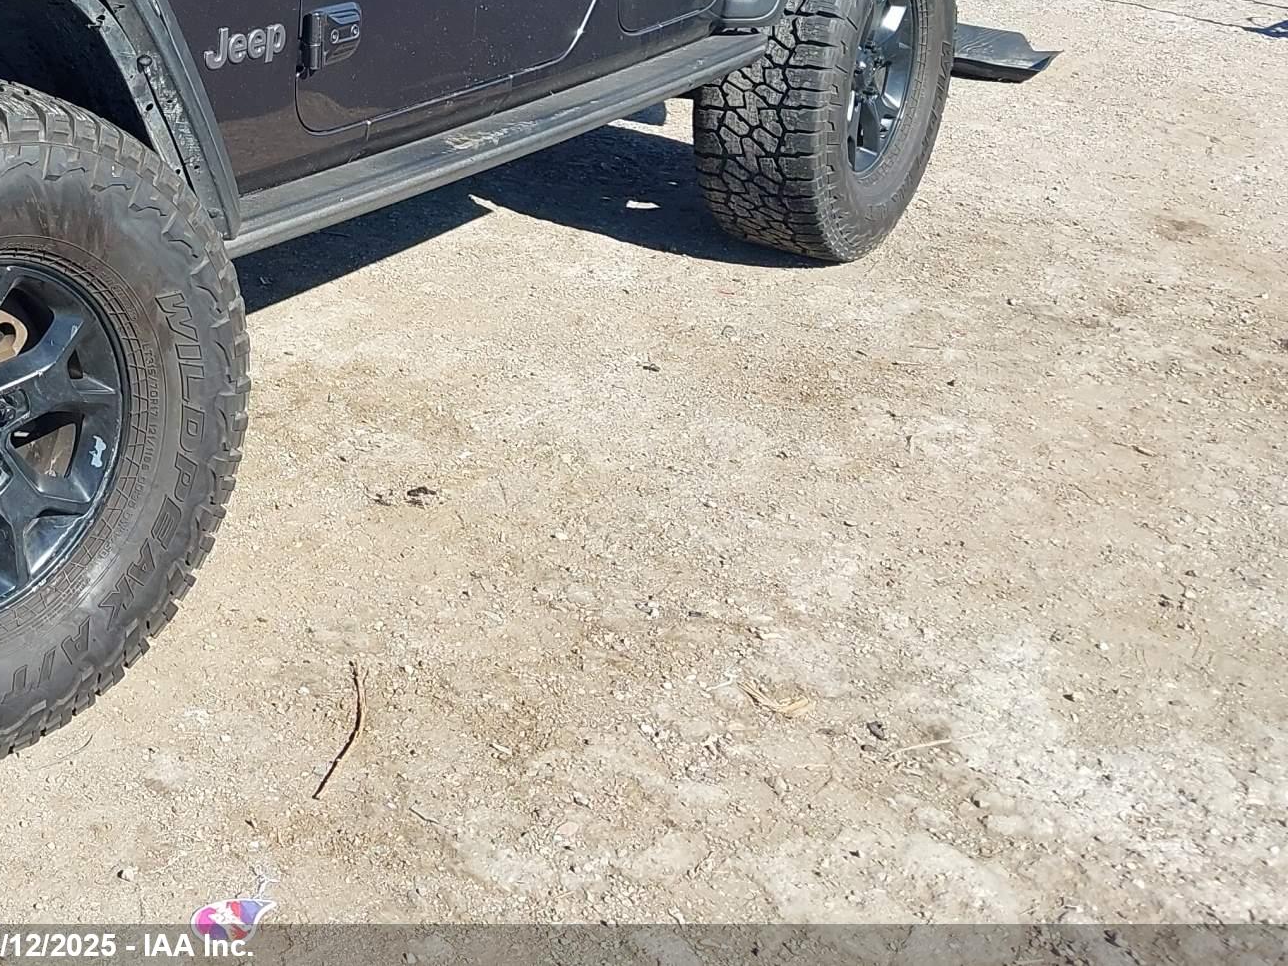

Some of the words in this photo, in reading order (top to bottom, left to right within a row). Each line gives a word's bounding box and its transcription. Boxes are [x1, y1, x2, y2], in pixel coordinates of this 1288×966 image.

[203, 24, 286, 69] Jeep
[98, 290, 206, 632] WILDPEAK
[1, 615, 92, 705] A/T
